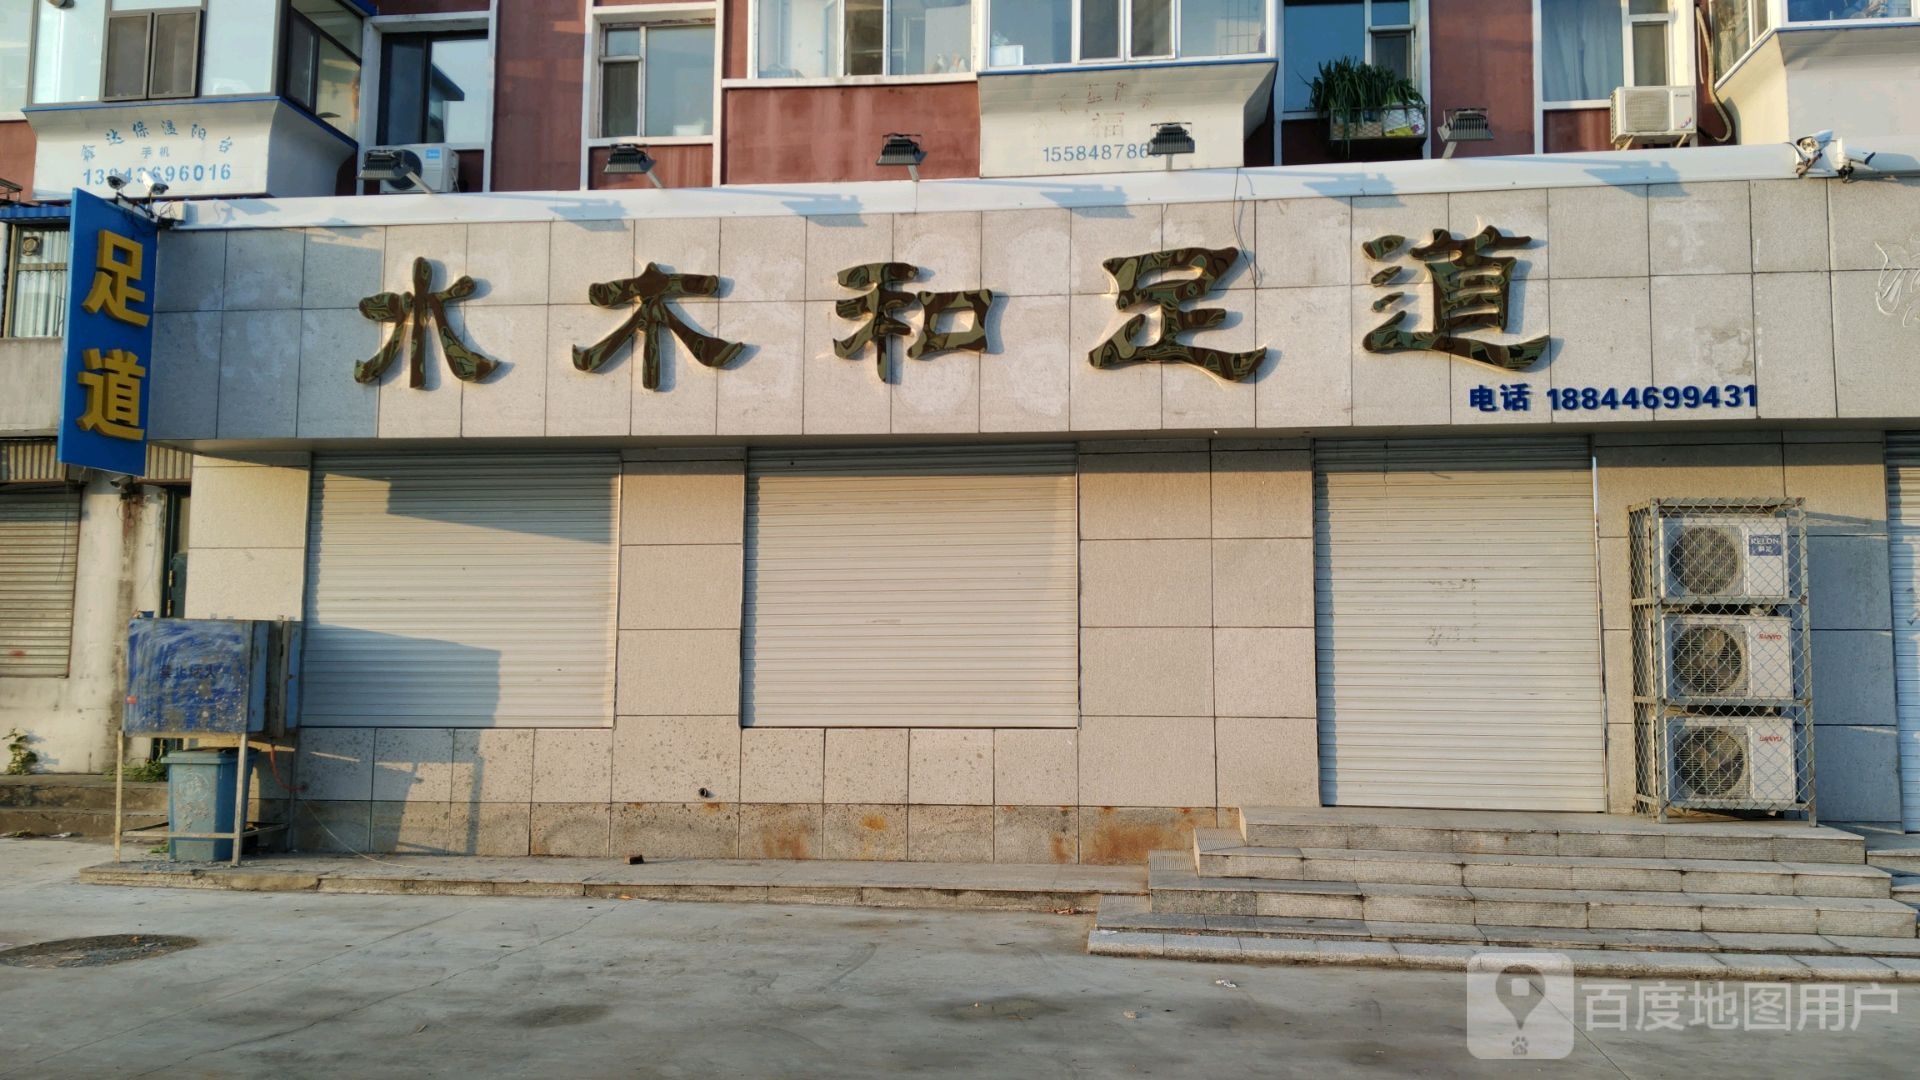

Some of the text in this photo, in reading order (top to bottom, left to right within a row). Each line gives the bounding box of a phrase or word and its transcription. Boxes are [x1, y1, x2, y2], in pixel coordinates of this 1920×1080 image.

[1043, 142, 1163, 162] 155848786
[76, 229, 150, 442] 足道
[355, 226, 1551, 393] 水木和足道
[1469, 383, 1758, 412] 电话 18844699431
